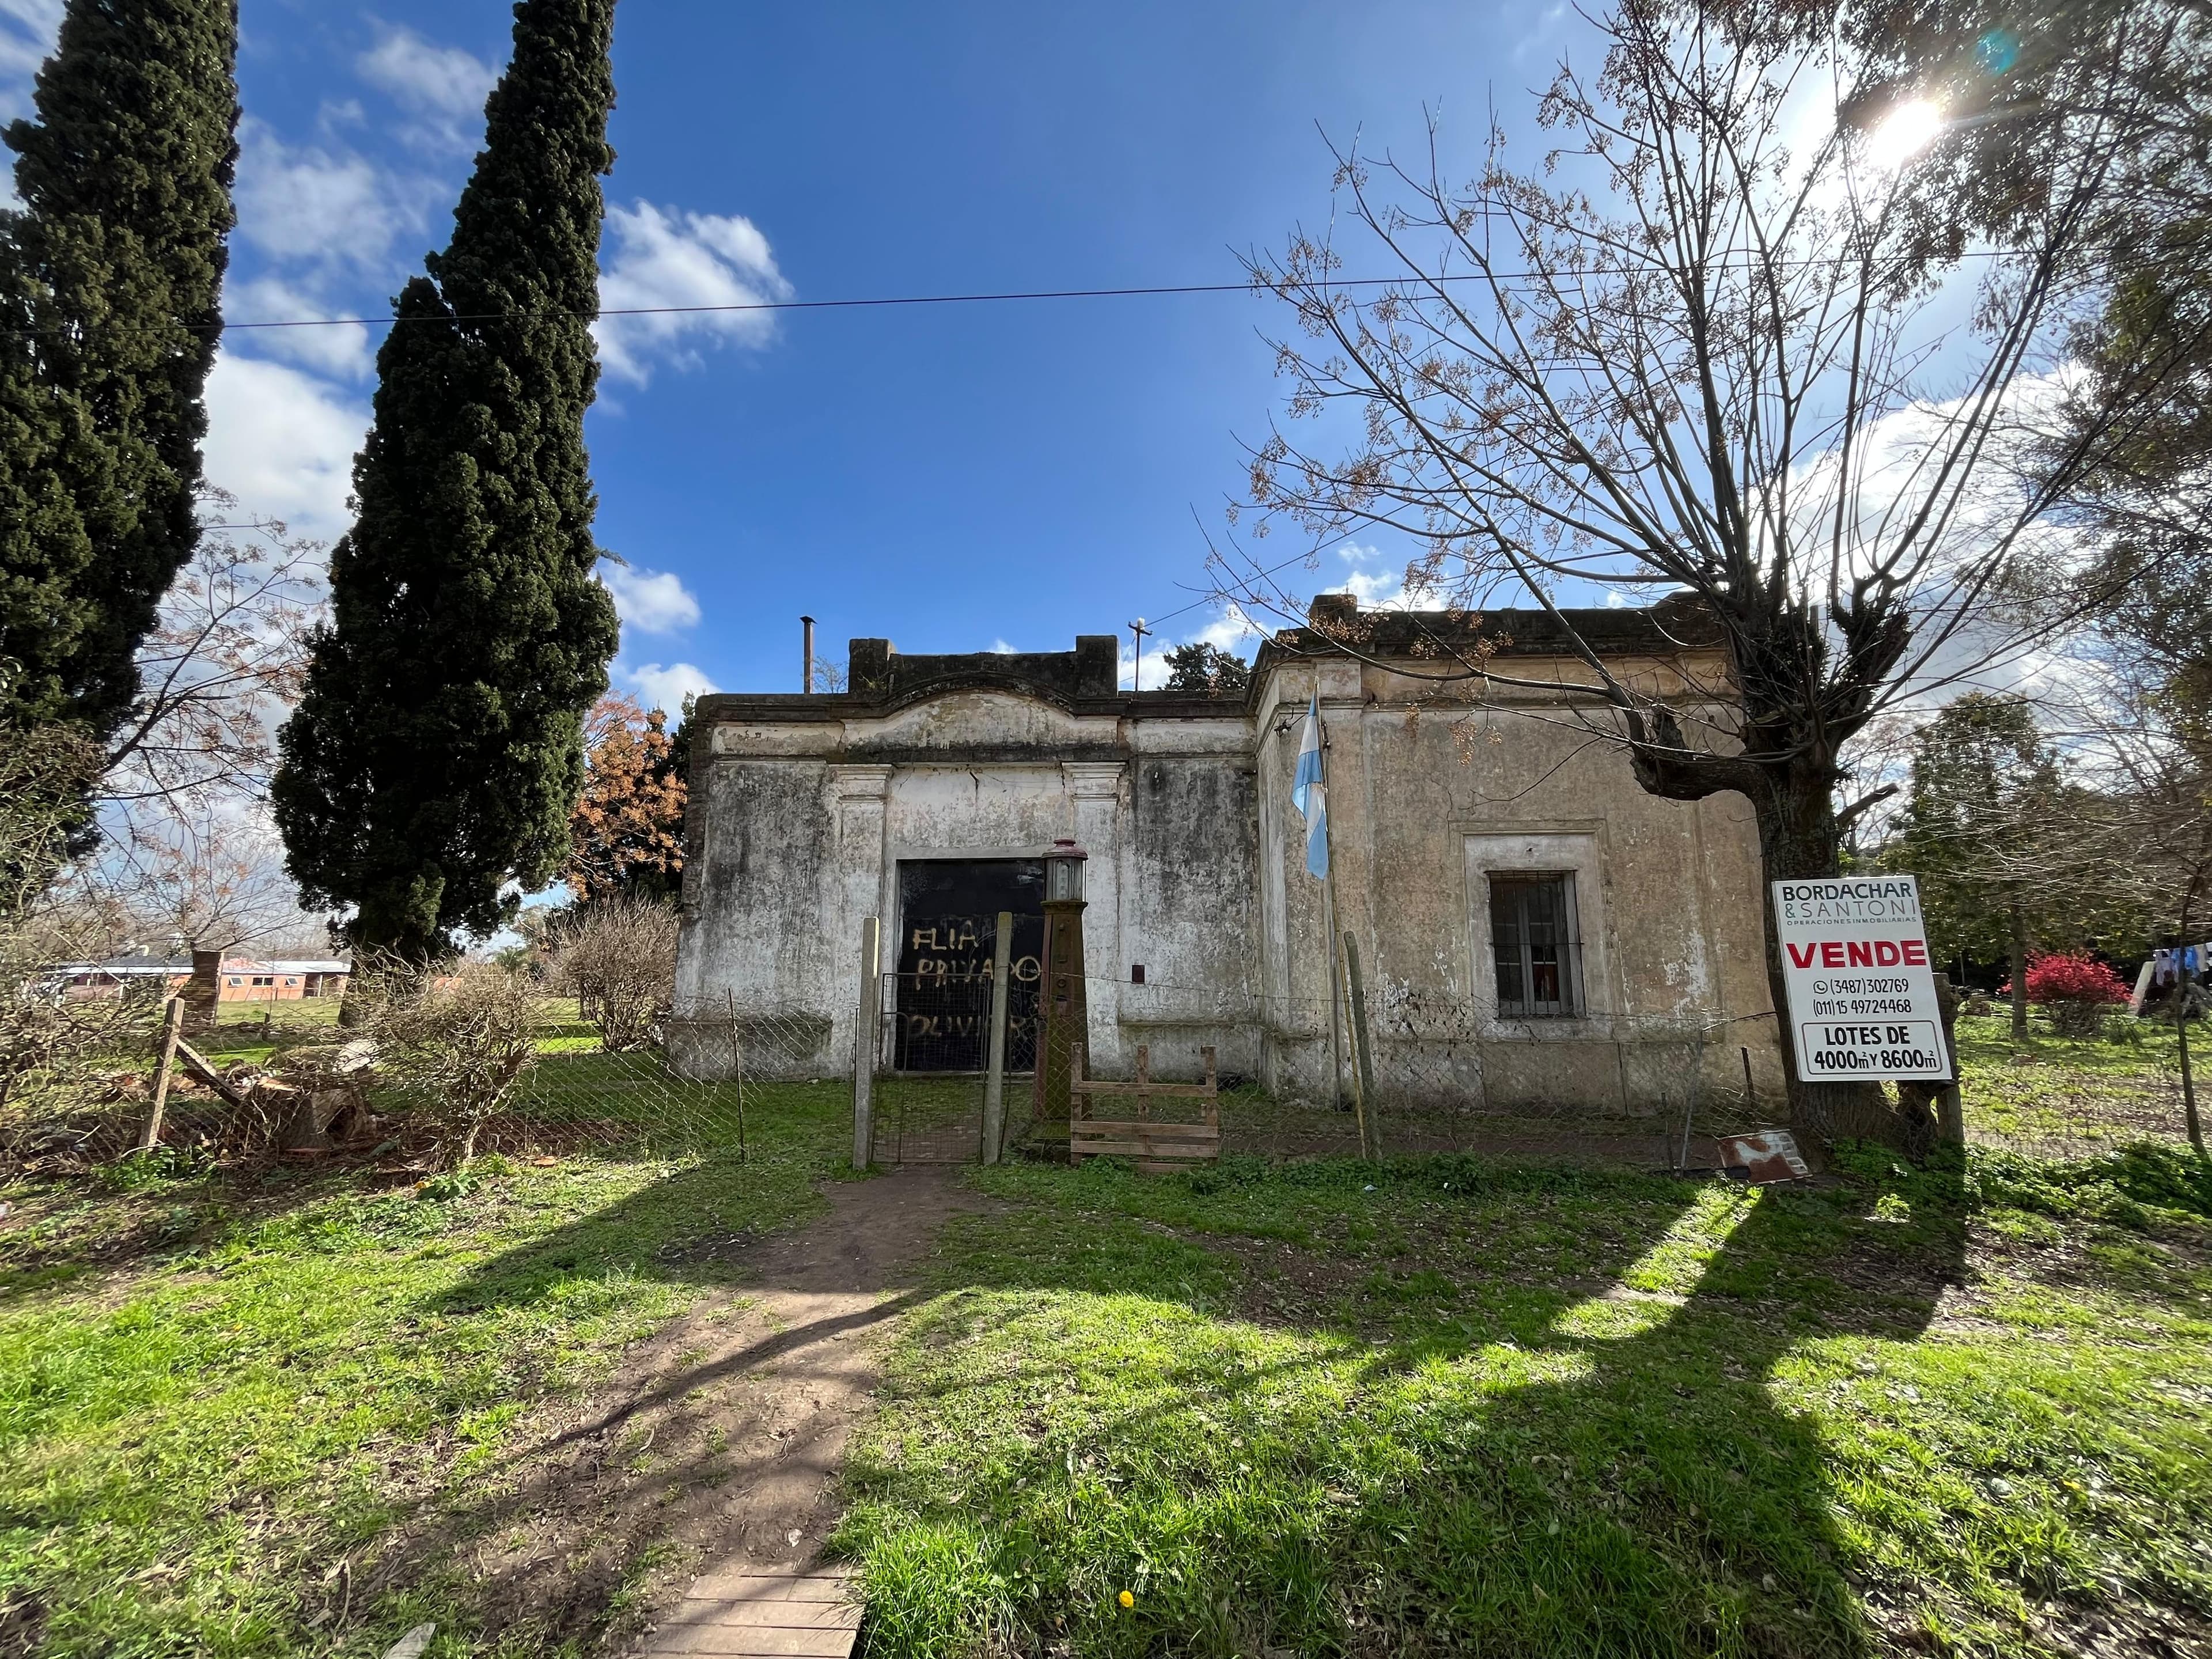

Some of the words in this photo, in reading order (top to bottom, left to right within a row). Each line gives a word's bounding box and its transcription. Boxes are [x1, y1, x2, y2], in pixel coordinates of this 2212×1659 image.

[1782, 882, 1912, 901] BORDACHAR
[912, 920, 979, 950] FLIA
[1786, 940, 1927, 968] VENDE
[917, 956, 1041, 990] PRIVAO
[1851, 999, 1912, 1014] 49724468
[1824, 1027, 1882, 1046] LOTES
[1886, 1026, 1911, 1044] DE
